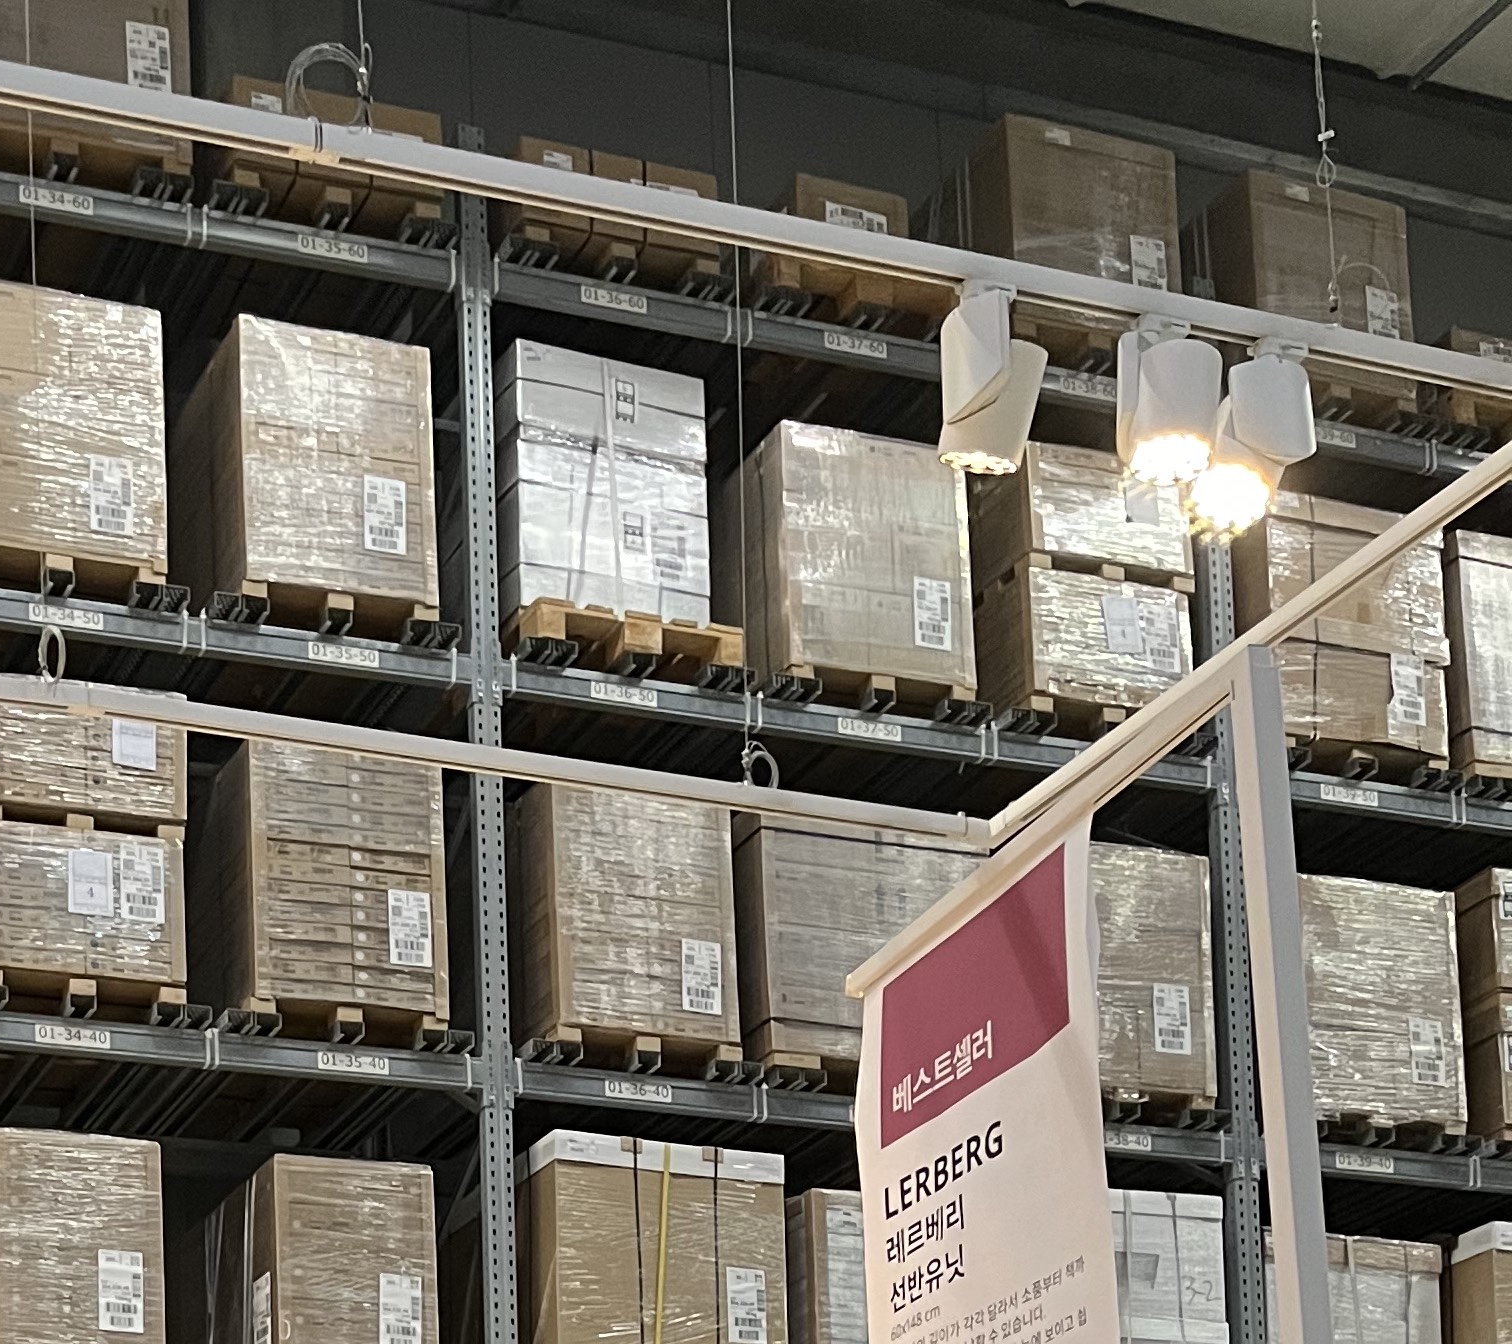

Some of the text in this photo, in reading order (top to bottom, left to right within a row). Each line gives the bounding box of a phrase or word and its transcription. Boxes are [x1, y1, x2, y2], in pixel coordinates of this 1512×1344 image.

[22, 187, 90, 210] 01-34-60
[300, 235, 365, 258] 01-35-60
[584, 287, 644, 309] 01-36-60
[826, 333, 885, 354] 01-37-60
[32, 605, 100, 625] 01-34-50
[311, 644, 377, 664] 01-35-50
[593, 683, 655, 703] 01-36-50
[839, 719, 899, 738] 01-37-50
[1323, 784, 1376, 803] 01-39-50
[38, 1026, 107, 1046] 01-34-40
[321, 1053, 386, 1071] 01-35-40
[892, 1019, 993, 1113] 베스트셀러
[607, 1081, 668, 1099] 01-36-40
[884, 1120, 1003, 1220] LERBERG
[1338, 1153, 1392, 1170] 01-39-40
[886, 1194, 965, 1263] 레르베리
[890, 1244, 965, 1313] 선반유닛
[964, 1310, 984, 1331] 각각
[988, 1291, 1018, 1321] 달라서
[1022, 1268, 1062, 1304] 소품부터
[925, 1306, 940, 1322] cm
[989, 1328, 998, 1344] 수
[1045, 1314, 1074, 1343] 보이고
